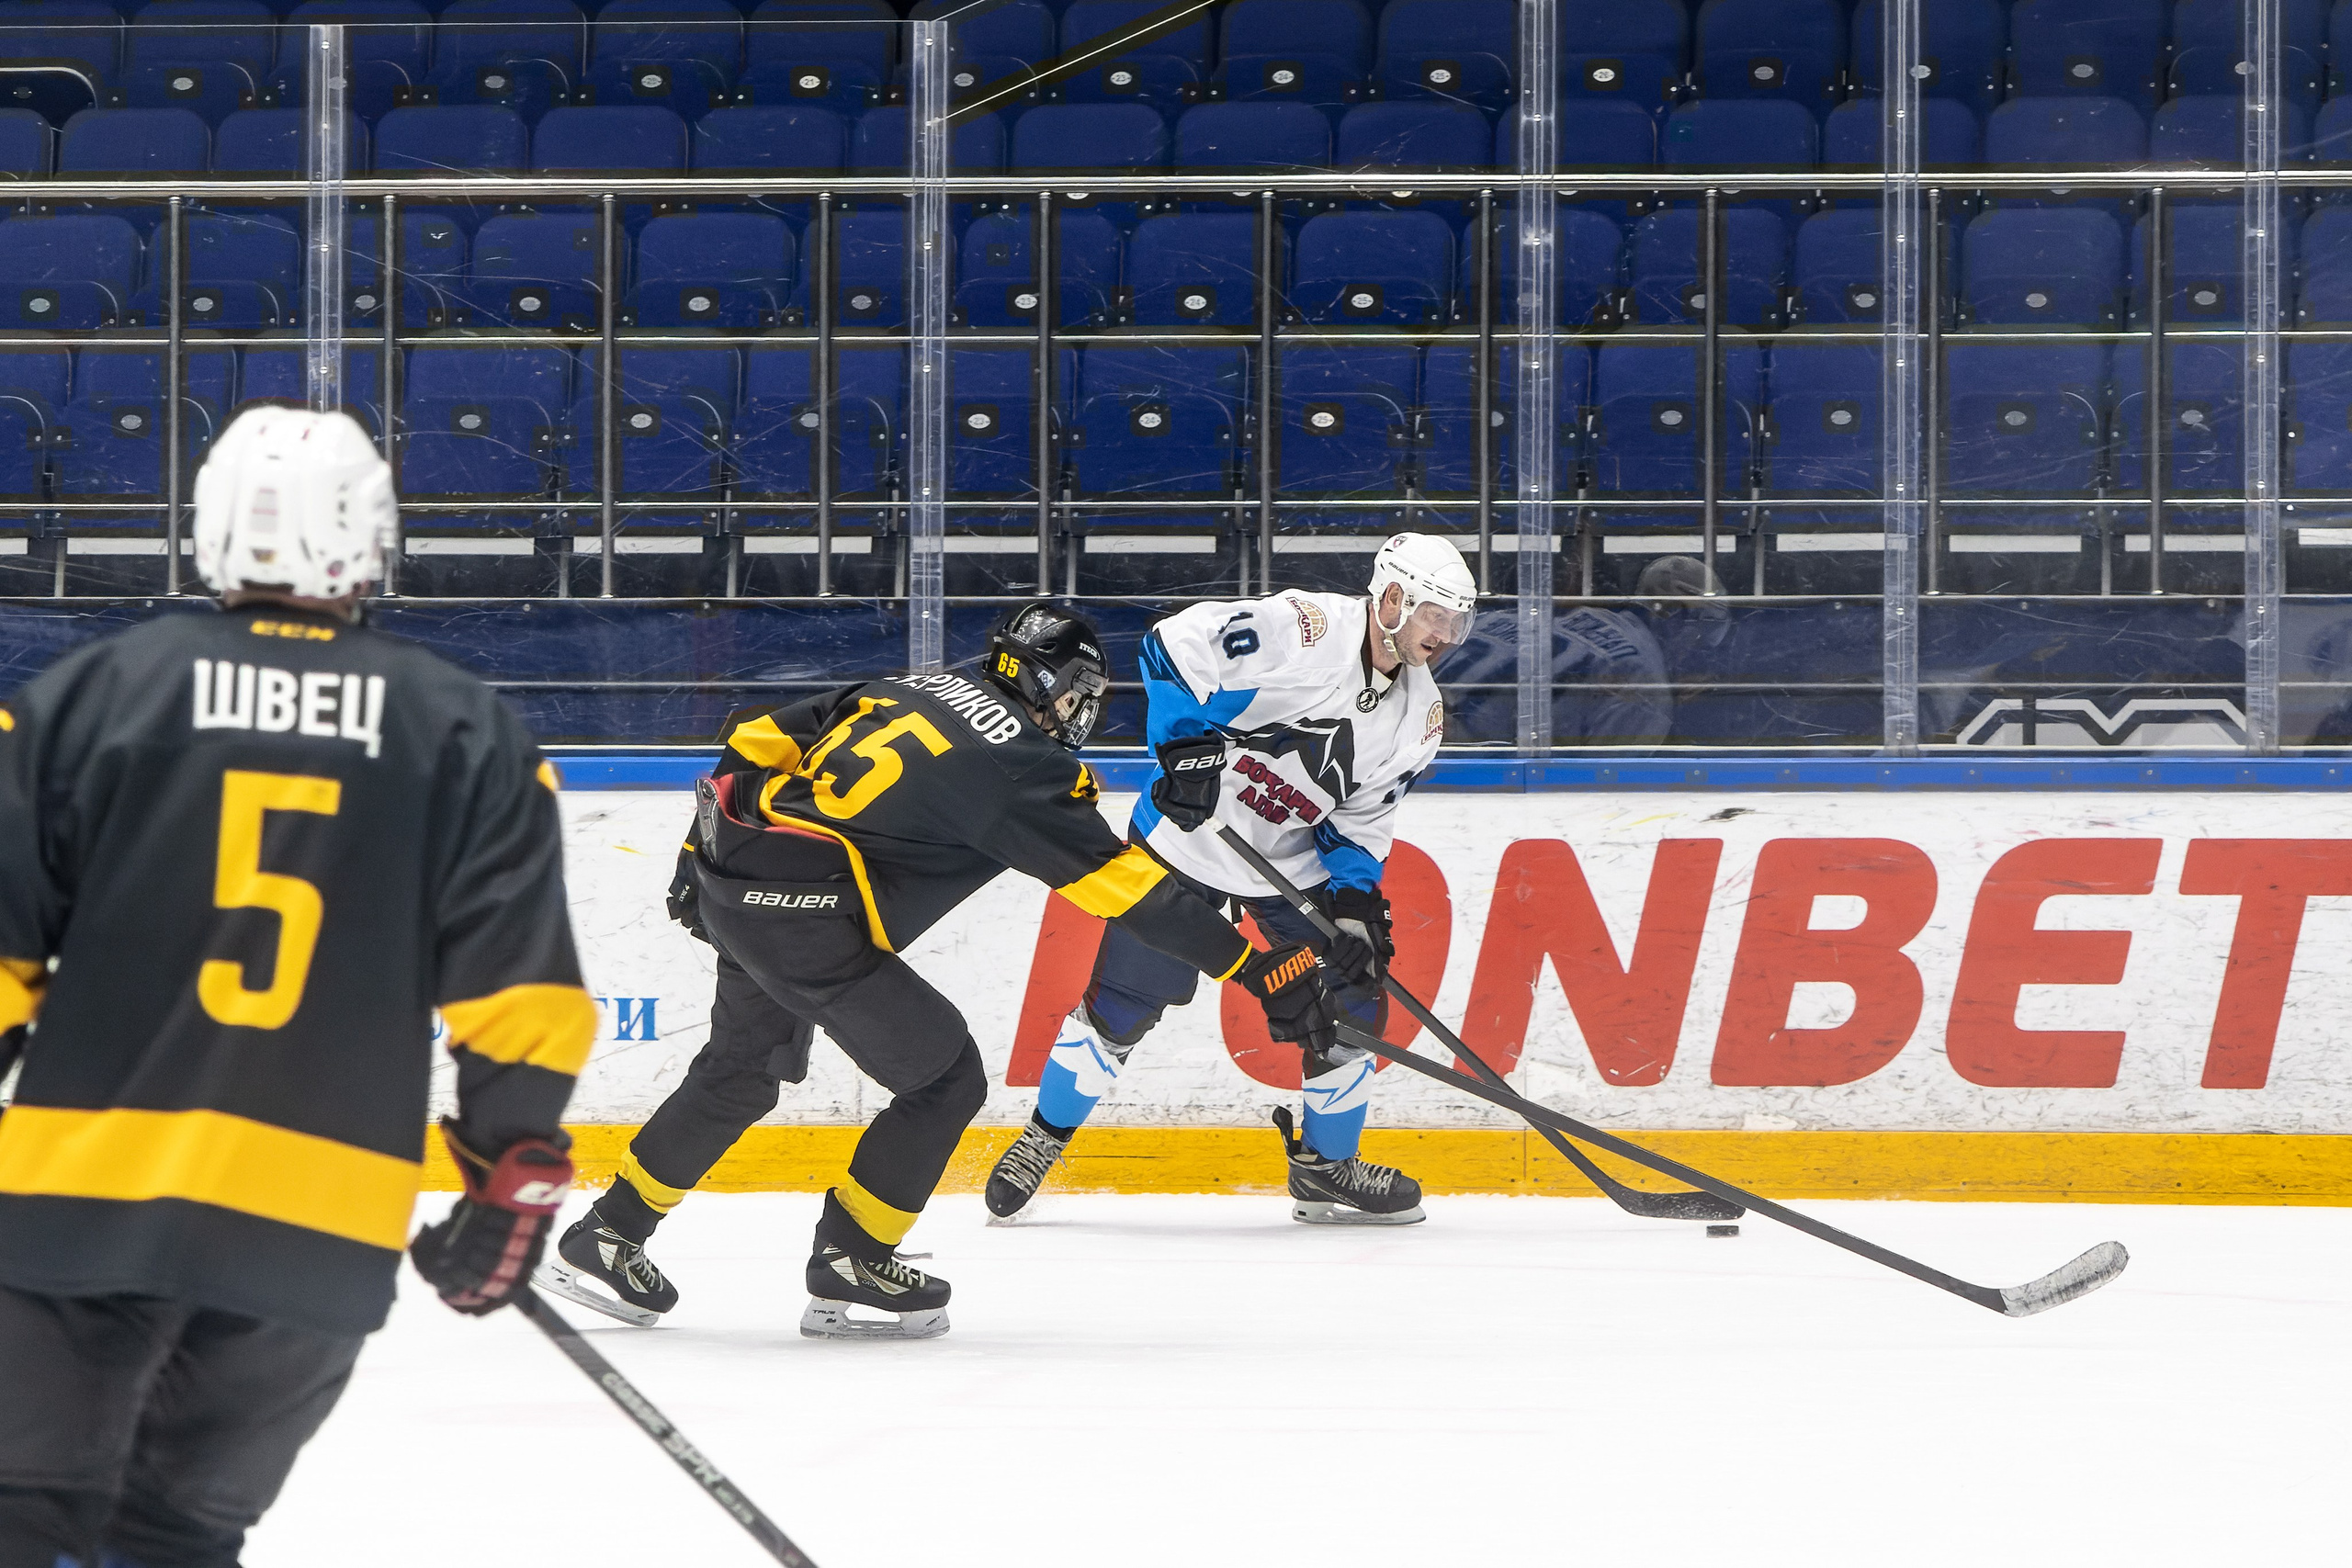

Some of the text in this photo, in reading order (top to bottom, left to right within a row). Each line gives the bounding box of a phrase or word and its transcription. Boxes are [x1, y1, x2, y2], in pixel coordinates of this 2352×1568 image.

[997, 652, 1021, 678] 65
[193, 659, 386, 759] ШВЕЦ
[198, 769, 342, 1030] 5
[742, 890, 839, 909] BAUER
